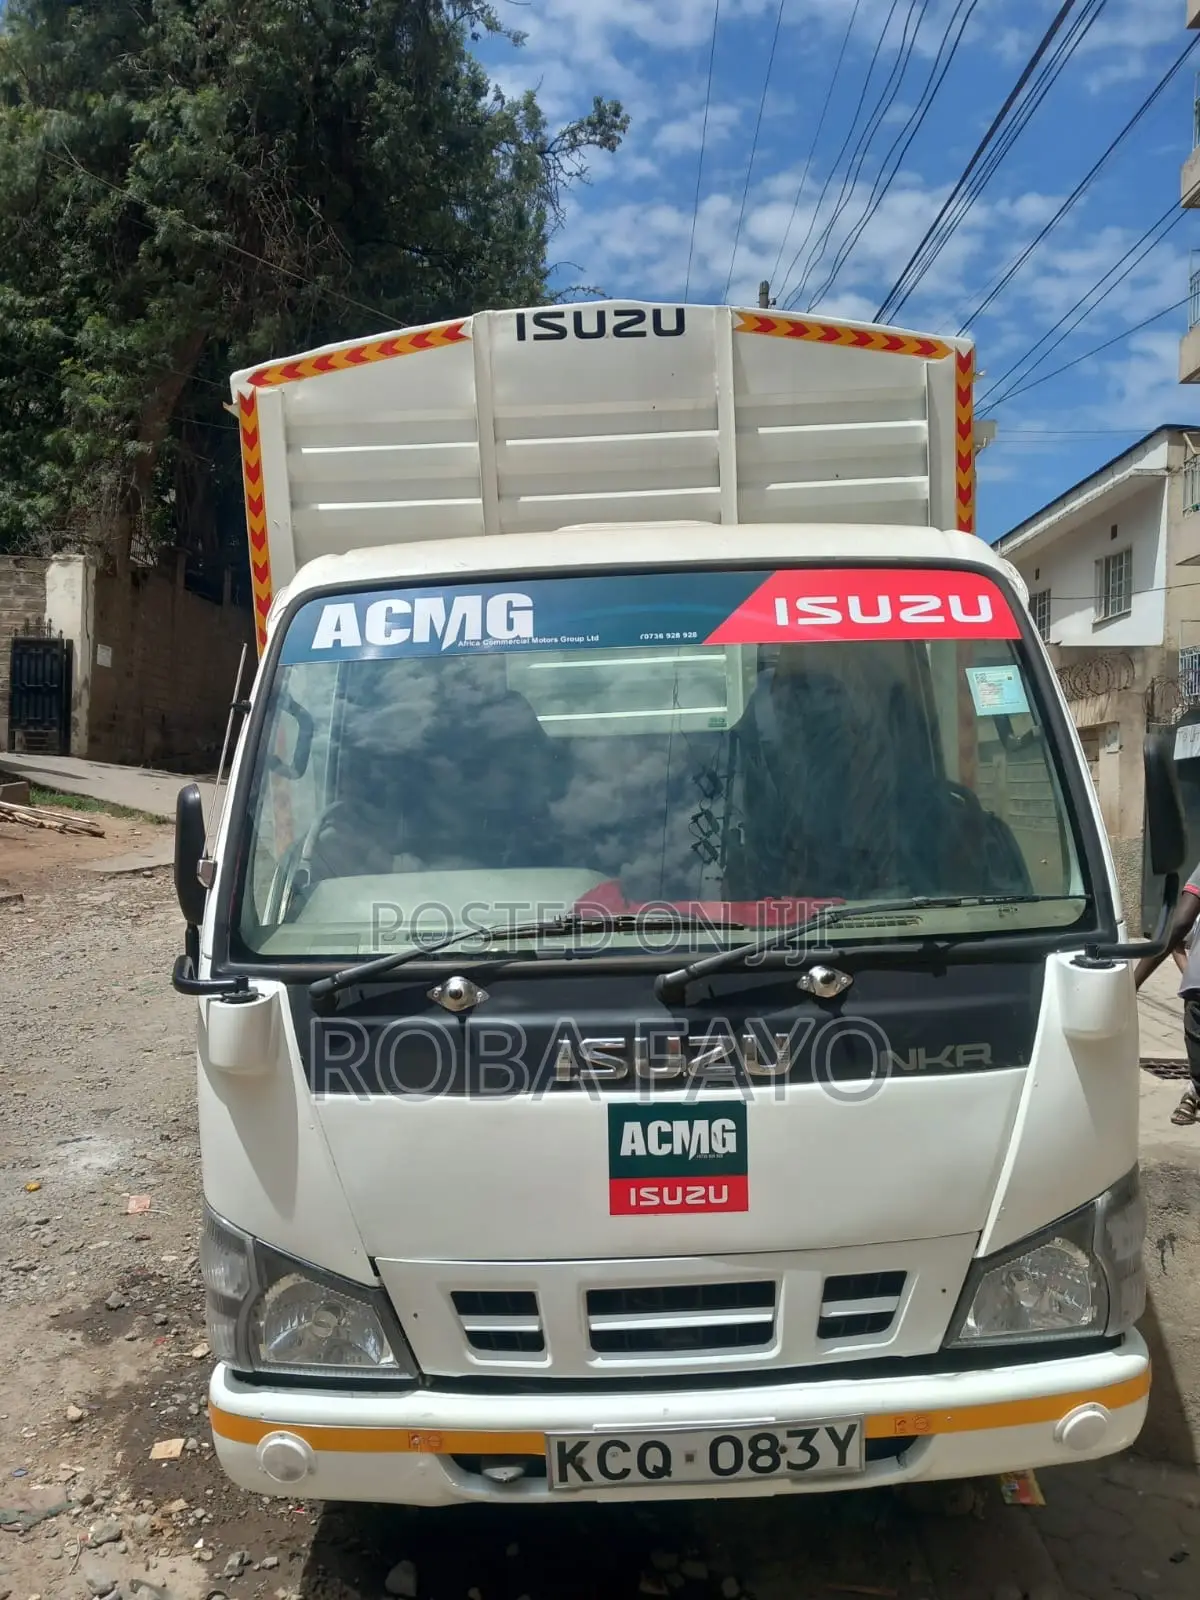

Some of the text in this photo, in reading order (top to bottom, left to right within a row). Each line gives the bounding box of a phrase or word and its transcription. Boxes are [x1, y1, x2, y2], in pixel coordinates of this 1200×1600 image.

[516, 308, 685, 341] ISUZU
[311, 593, 534, 651] ACMG
[775, 595, 993, 626] ISUZU
[457, 634, 600, 648] Africa Commercial Motors Group Ltd
[555, 1033, 793, 1082] ISUZU
[879, 1043, 993, 1073] NKR
[620, 1118, 737, 1161] ACMG
[630, 1185, 728, 1207] ISUZU
[556, 1423, 857, 1483] KCQ 083Y
